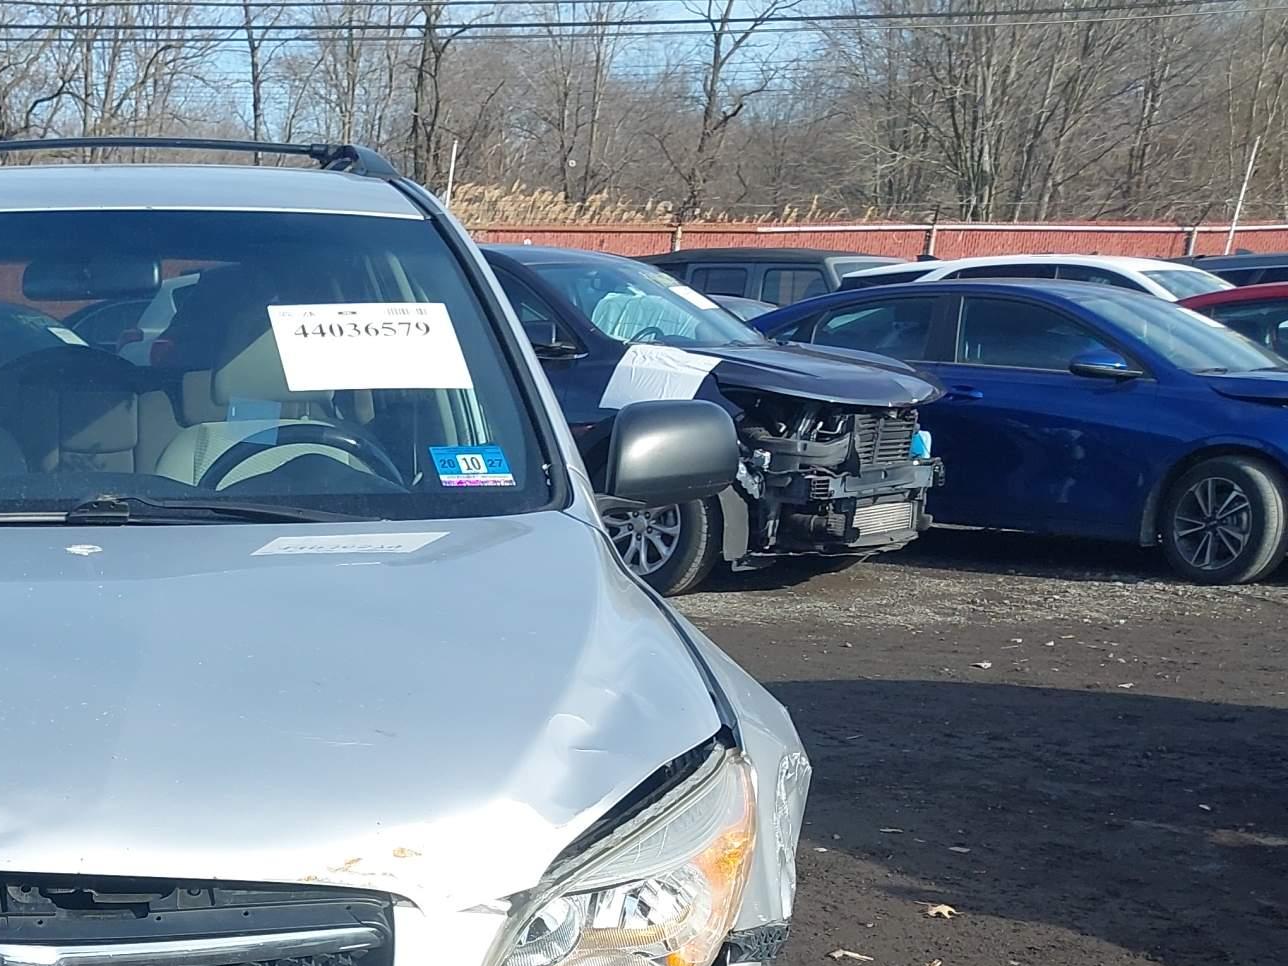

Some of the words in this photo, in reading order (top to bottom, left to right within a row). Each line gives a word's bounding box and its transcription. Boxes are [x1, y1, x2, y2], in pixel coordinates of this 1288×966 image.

[294, 321, 431, 338] 44036579
[439, 458, 457, 469] 20
[462, 456, 482, 471] 10
[487, 458, 503, 468] 27
